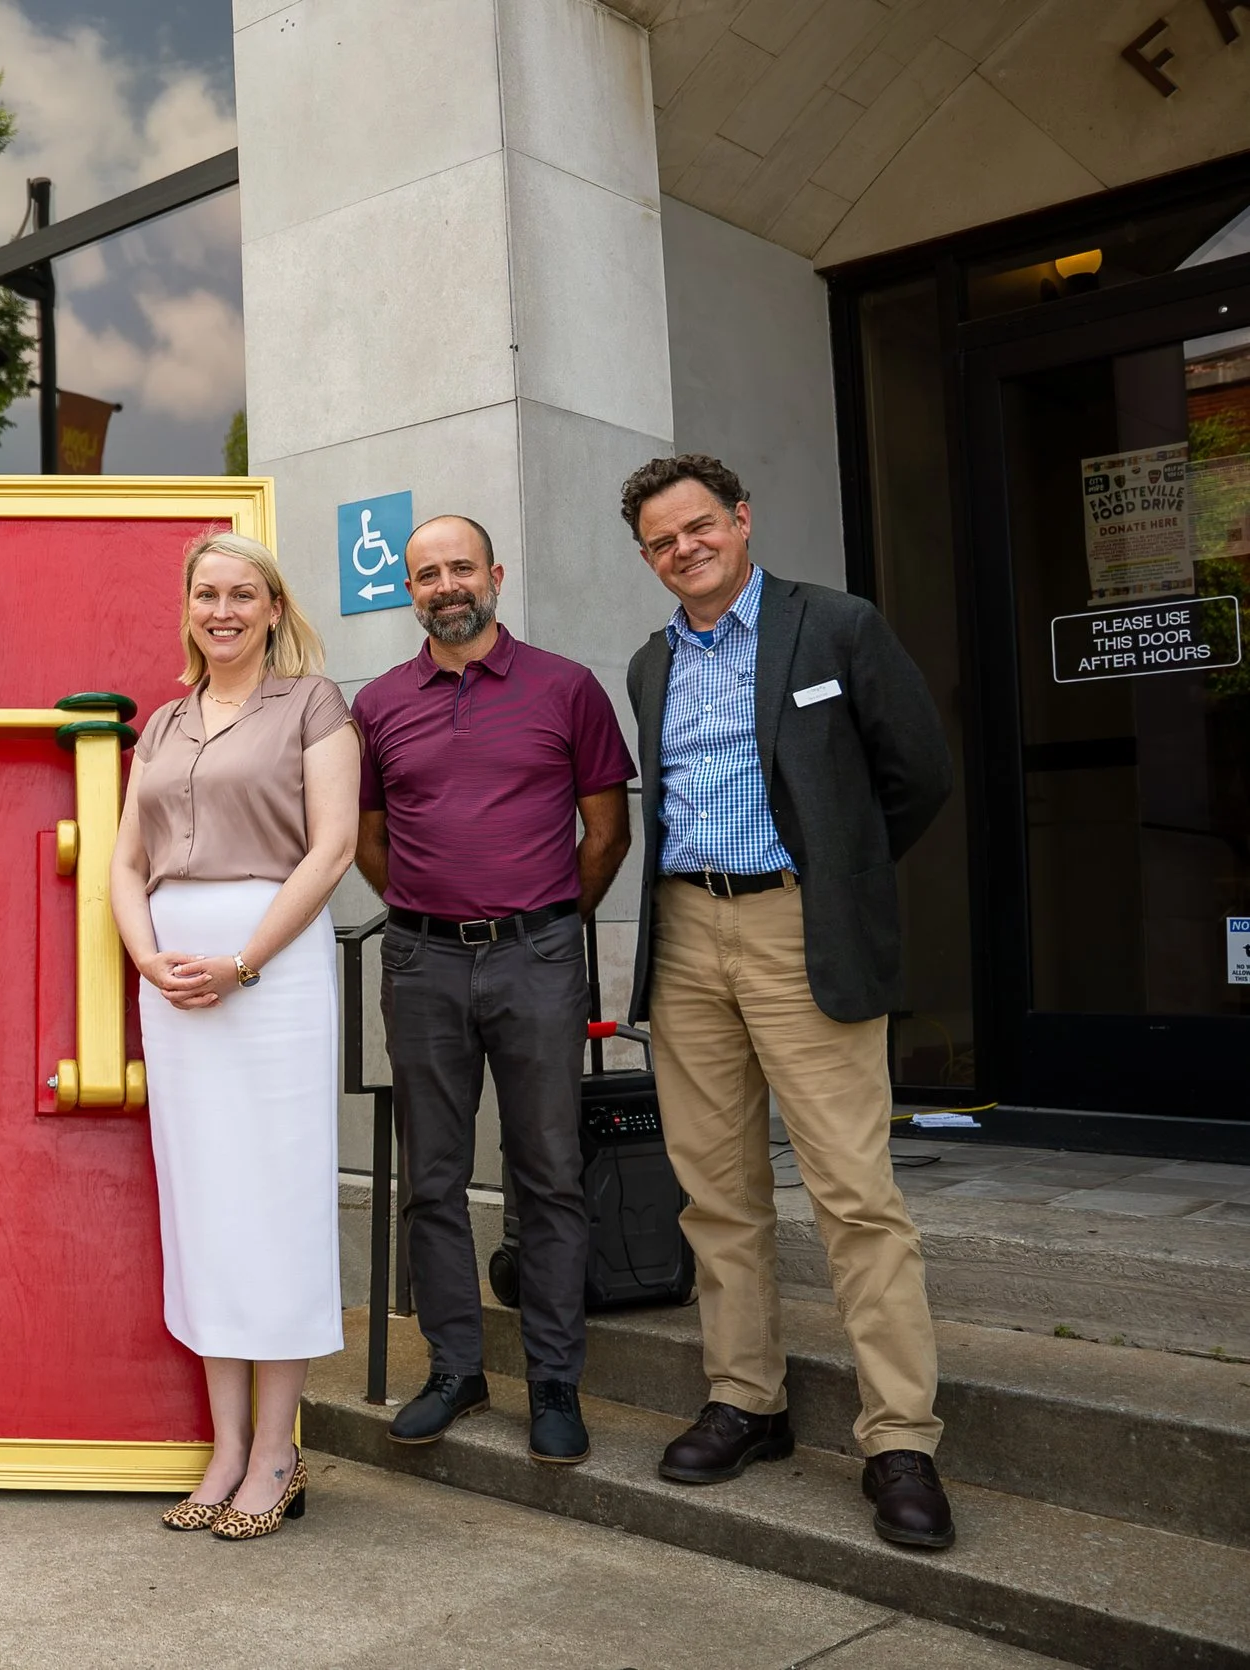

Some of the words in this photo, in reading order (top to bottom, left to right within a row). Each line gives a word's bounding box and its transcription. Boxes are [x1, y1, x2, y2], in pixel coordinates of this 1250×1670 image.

[1089, 485, 1185, 512] FAYETTEVILLE
[1092, 502, 1136, 524] FOOD
[1141, 497, 1185, 512] DRIVE
[1099, 521, 1147, 537] DONATE
[1150, 517, 1178, 529] HERE
[1092, 615, 1153, 635] PLEASE
[1157, 610, 1191, 626] USE
[1093, 635, 1133, 653] THIS
[1138, 629, 1192, 647] DOOR
[1078, 652, 1137, 672] AFTER
[1142, 643, 1211, 665] HOURS
[1232, 920, 1250, 931] NO
